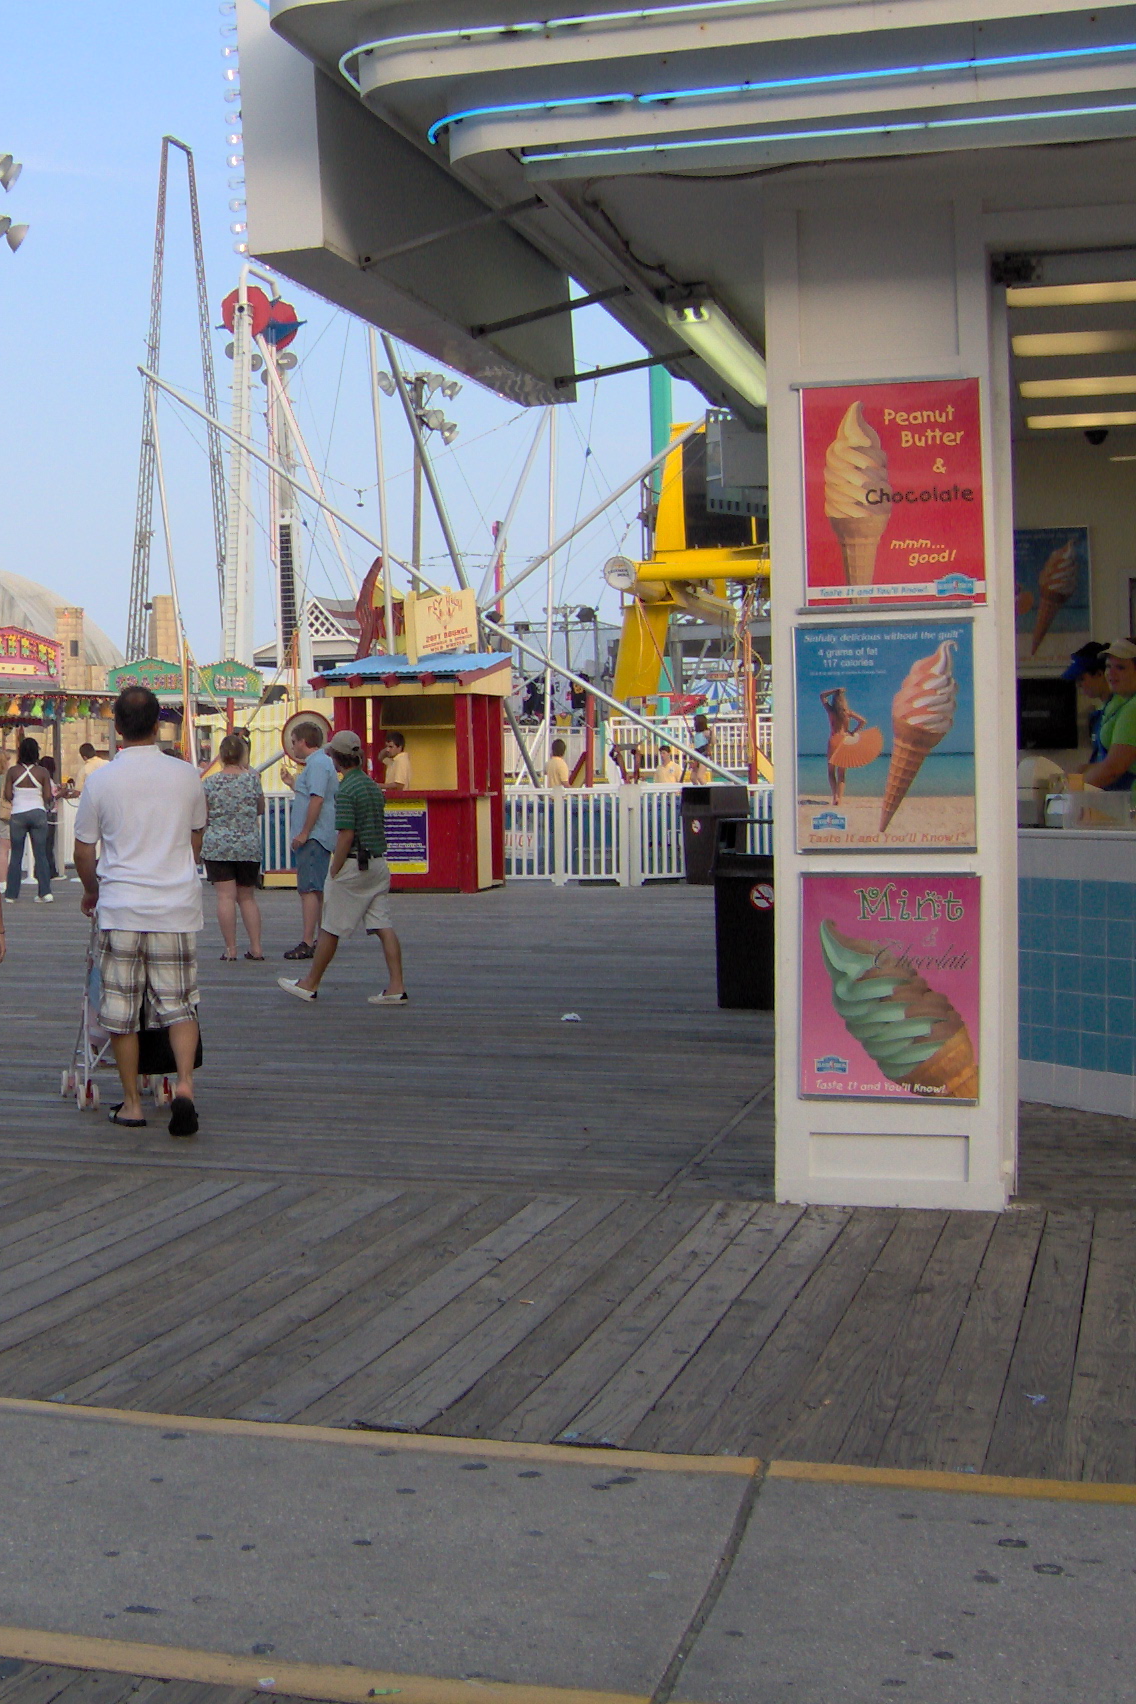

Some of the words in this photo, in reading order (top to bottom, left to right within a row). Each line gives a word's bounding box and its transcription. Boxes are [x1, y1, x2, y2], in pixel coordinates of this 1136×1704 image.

[883, 404, 956, 426] Peanut
[900, 428, 965, 448] Butter
[932, 457, 947, 474] &
[865, 484, 974, 506] Chocolate
[908, 549, 957, 567] good!
[819, 588, 842, 597] Taste
[857, 587, 874, 596] and
[803, 634, 837, 644] Sinfully
[839, 631, 881, 643] delicious
[883, 630, 918, 641] without
[920, 630, 937, 640] the
[826, 649, 854, 658] grams
[856, 648, 866, 656] of
[867, 647, 878, 656] fat
[823, 658, 838, 668] 117
[840, 657, 874, 667] calories
[808, 833, 841, 844] Taste
[845, 833, 854, 844] It
[858, 833, 879, 843] and
[882, 832, 917, 844] You'll
[854, 883, 965, 922] Mint
[873, 938, 971, 971] Chocolate
[815, 1079, 843, 1091] Taste
[847, 1080, 858, 1091] It
[860, 1081, 881, 1092] and
[884, 1082, 911, 1093] You'll
[913, 1083, 947, 1094] Know!
